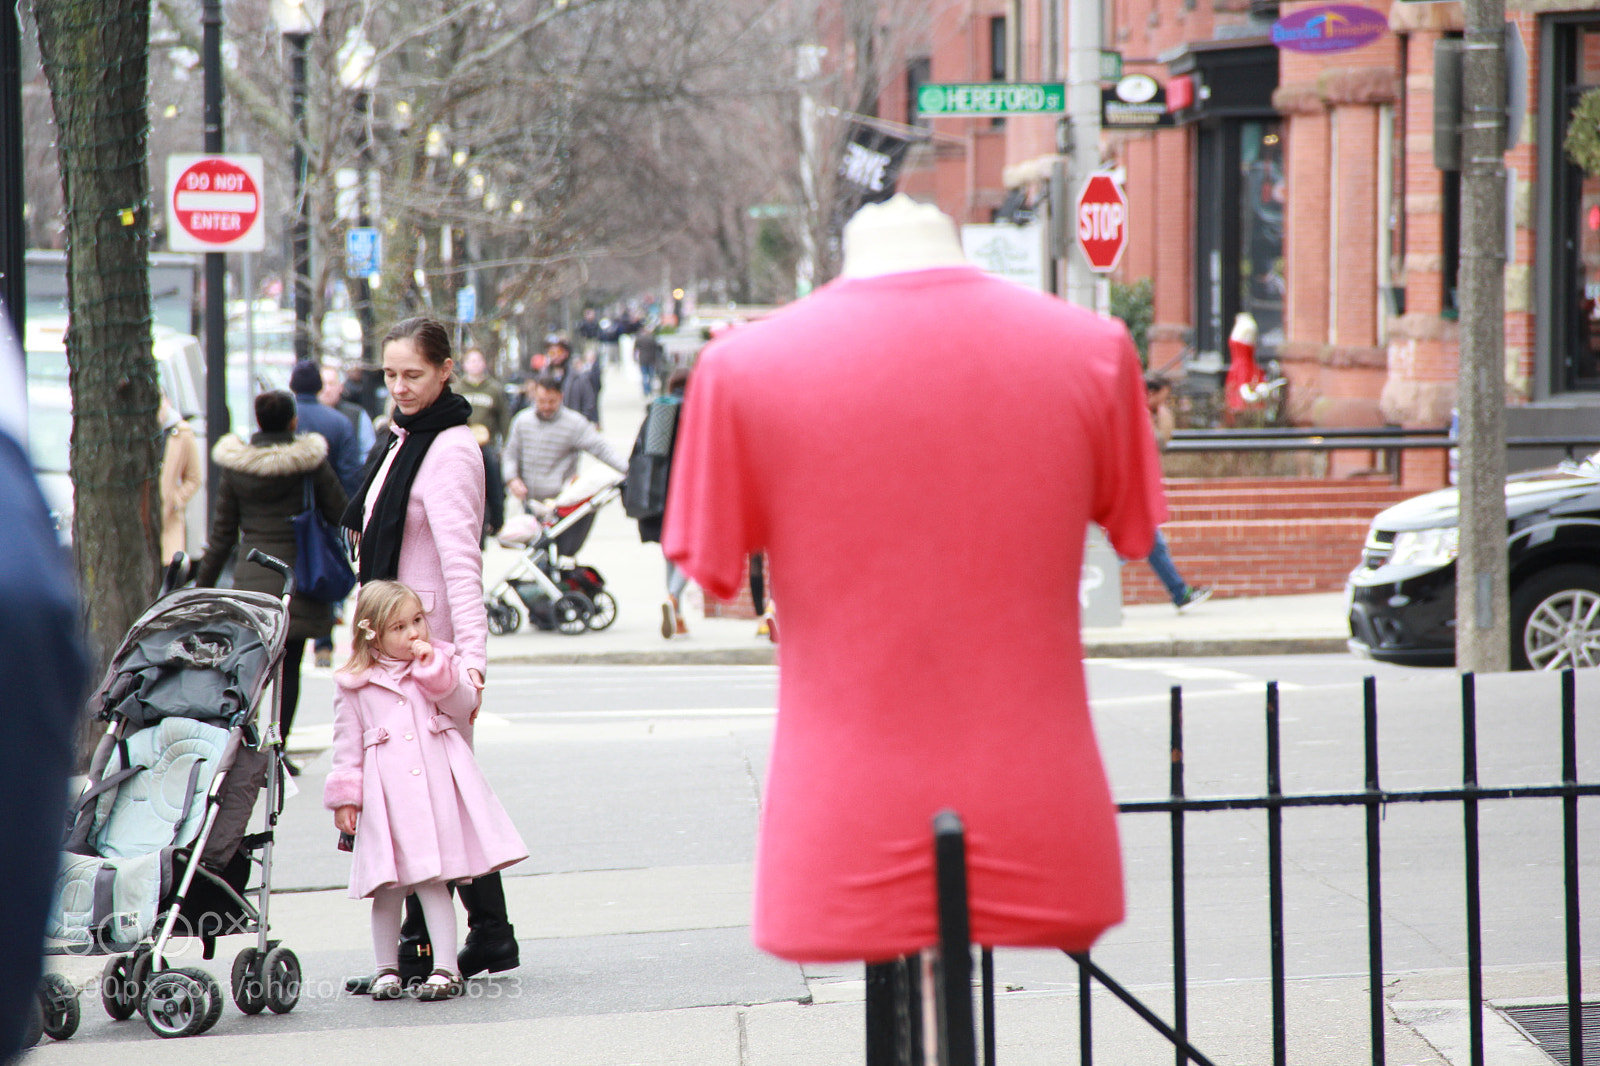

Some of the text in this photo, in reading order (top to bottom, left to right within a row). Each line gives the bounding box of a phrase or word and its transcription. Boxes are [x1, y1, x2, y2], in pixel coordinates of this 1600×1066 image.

[946, 86, 1046, 110] HEREFORD
[186, 172, 246, 191] DO NOT
[190, 211, 241, 231] ENTER
[1080, 202, 1124, 241] STOP
